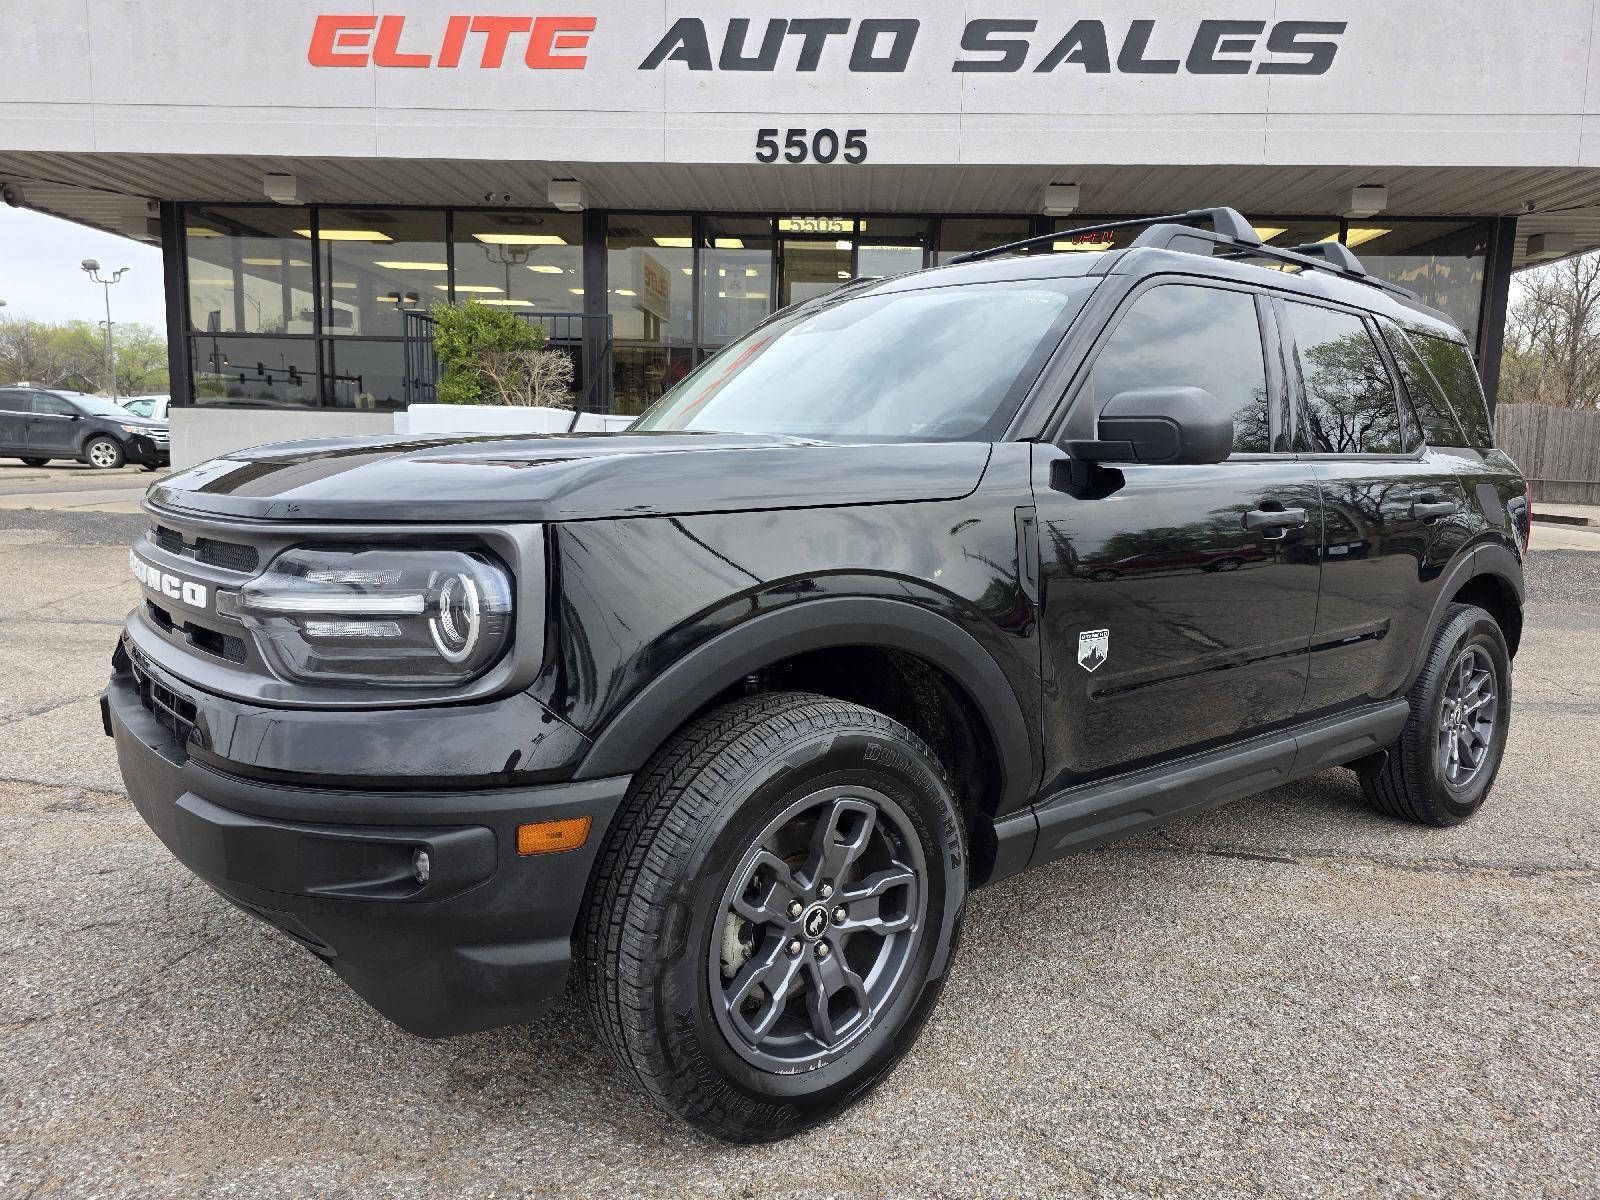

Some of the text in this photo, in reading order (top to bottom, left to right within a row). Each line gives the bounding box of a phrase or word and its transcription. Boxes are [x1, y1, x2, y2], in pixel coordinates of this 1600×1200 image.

[307, 15, 1348, 74] ELITE AUTO SALES
[756, 128, 868, 164] 5505
[790, 216, 843, 232] 5505
